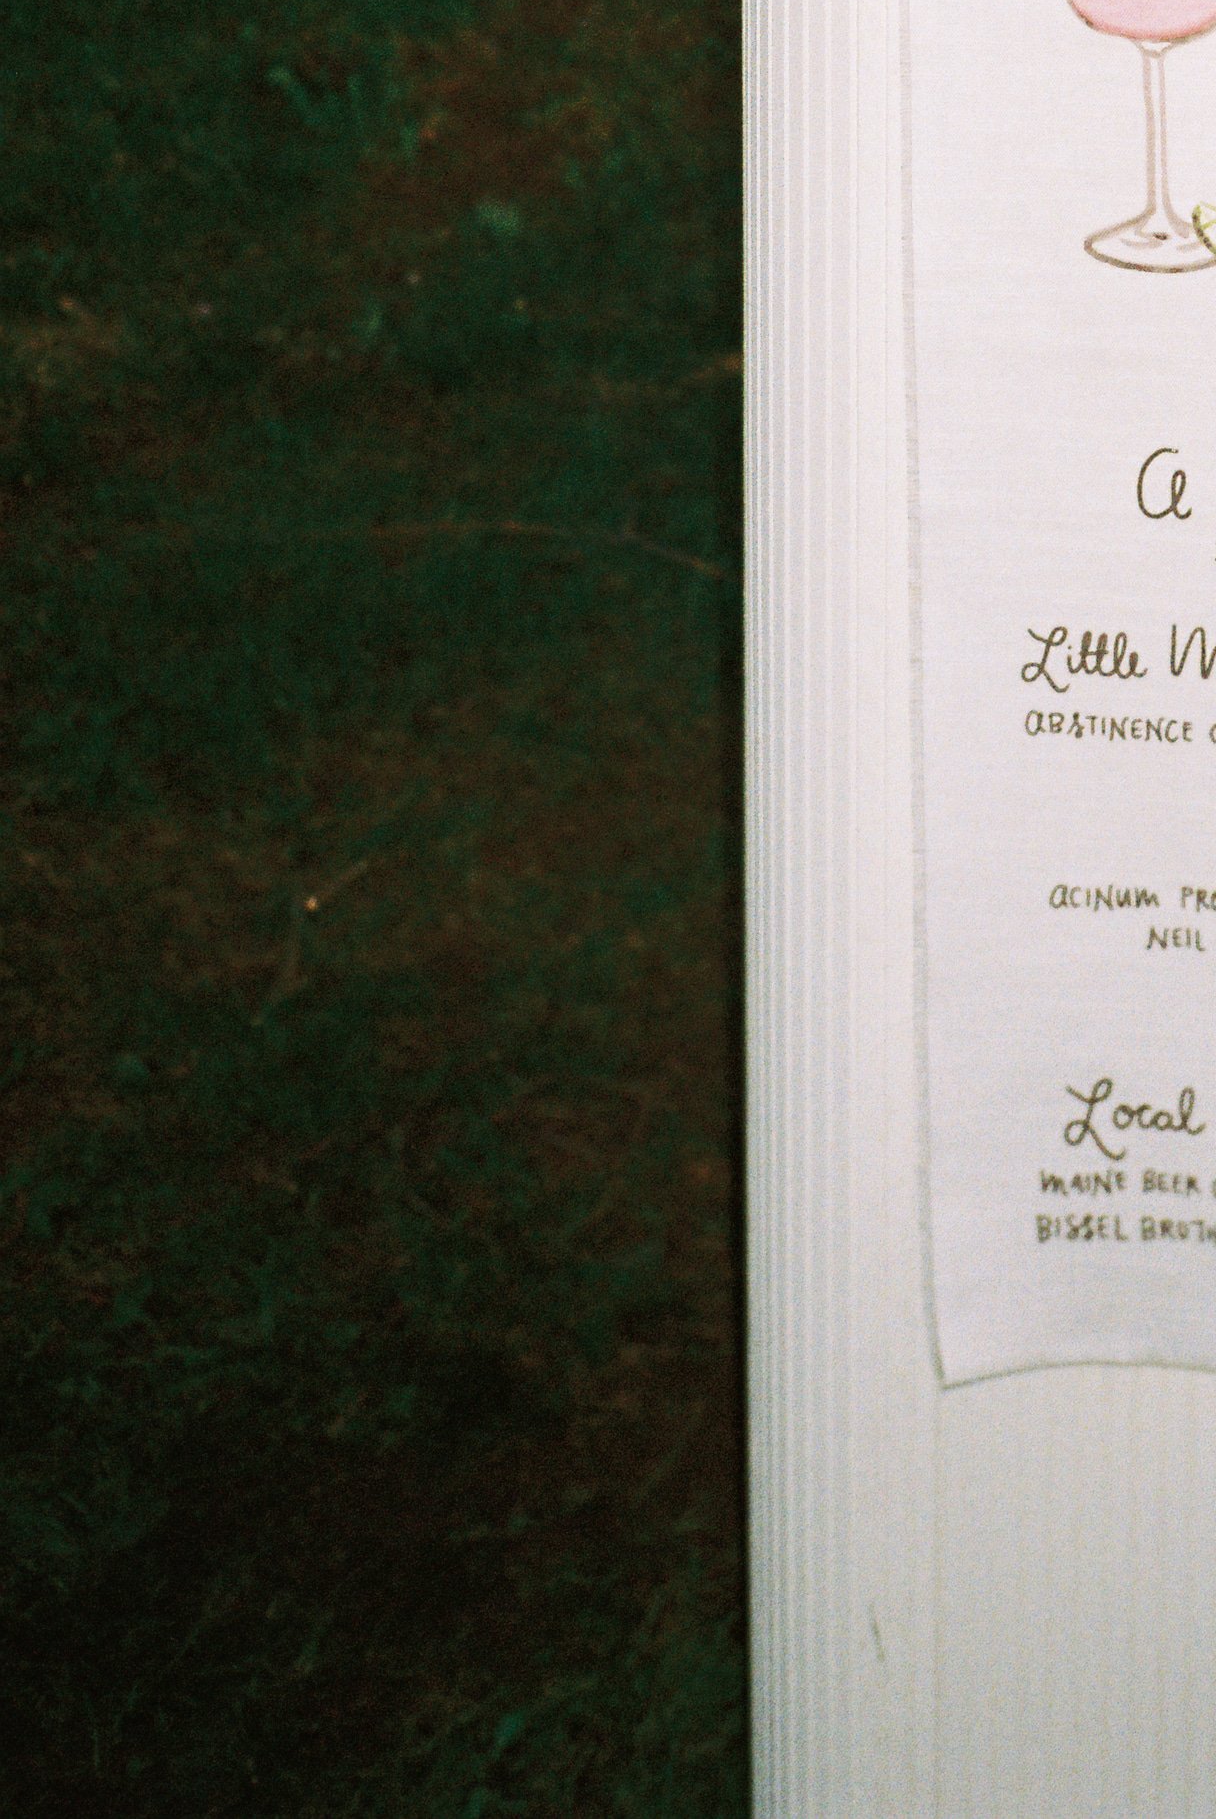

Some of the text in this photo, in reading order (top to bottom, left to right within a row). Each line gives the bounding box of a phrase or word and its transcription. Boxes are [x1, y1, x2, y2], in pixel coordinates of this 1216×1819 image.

[1136, 446, 1193, 521] A
[1020, 625, 1147, 694] Little
[1024, 710, 1192, 744] ABSTINENCE
[1048, 883, 1159, 912] ACINUM
[1145, 927, 1205, 952] NEIL
[1063, 1077, 1205, 1162] Local
[1040, 1171, 1124, 1196] MAINE
[1143, 1170, 1199, 1195] BEER
[1036, 1214, 1127, 1244] BISSEL
